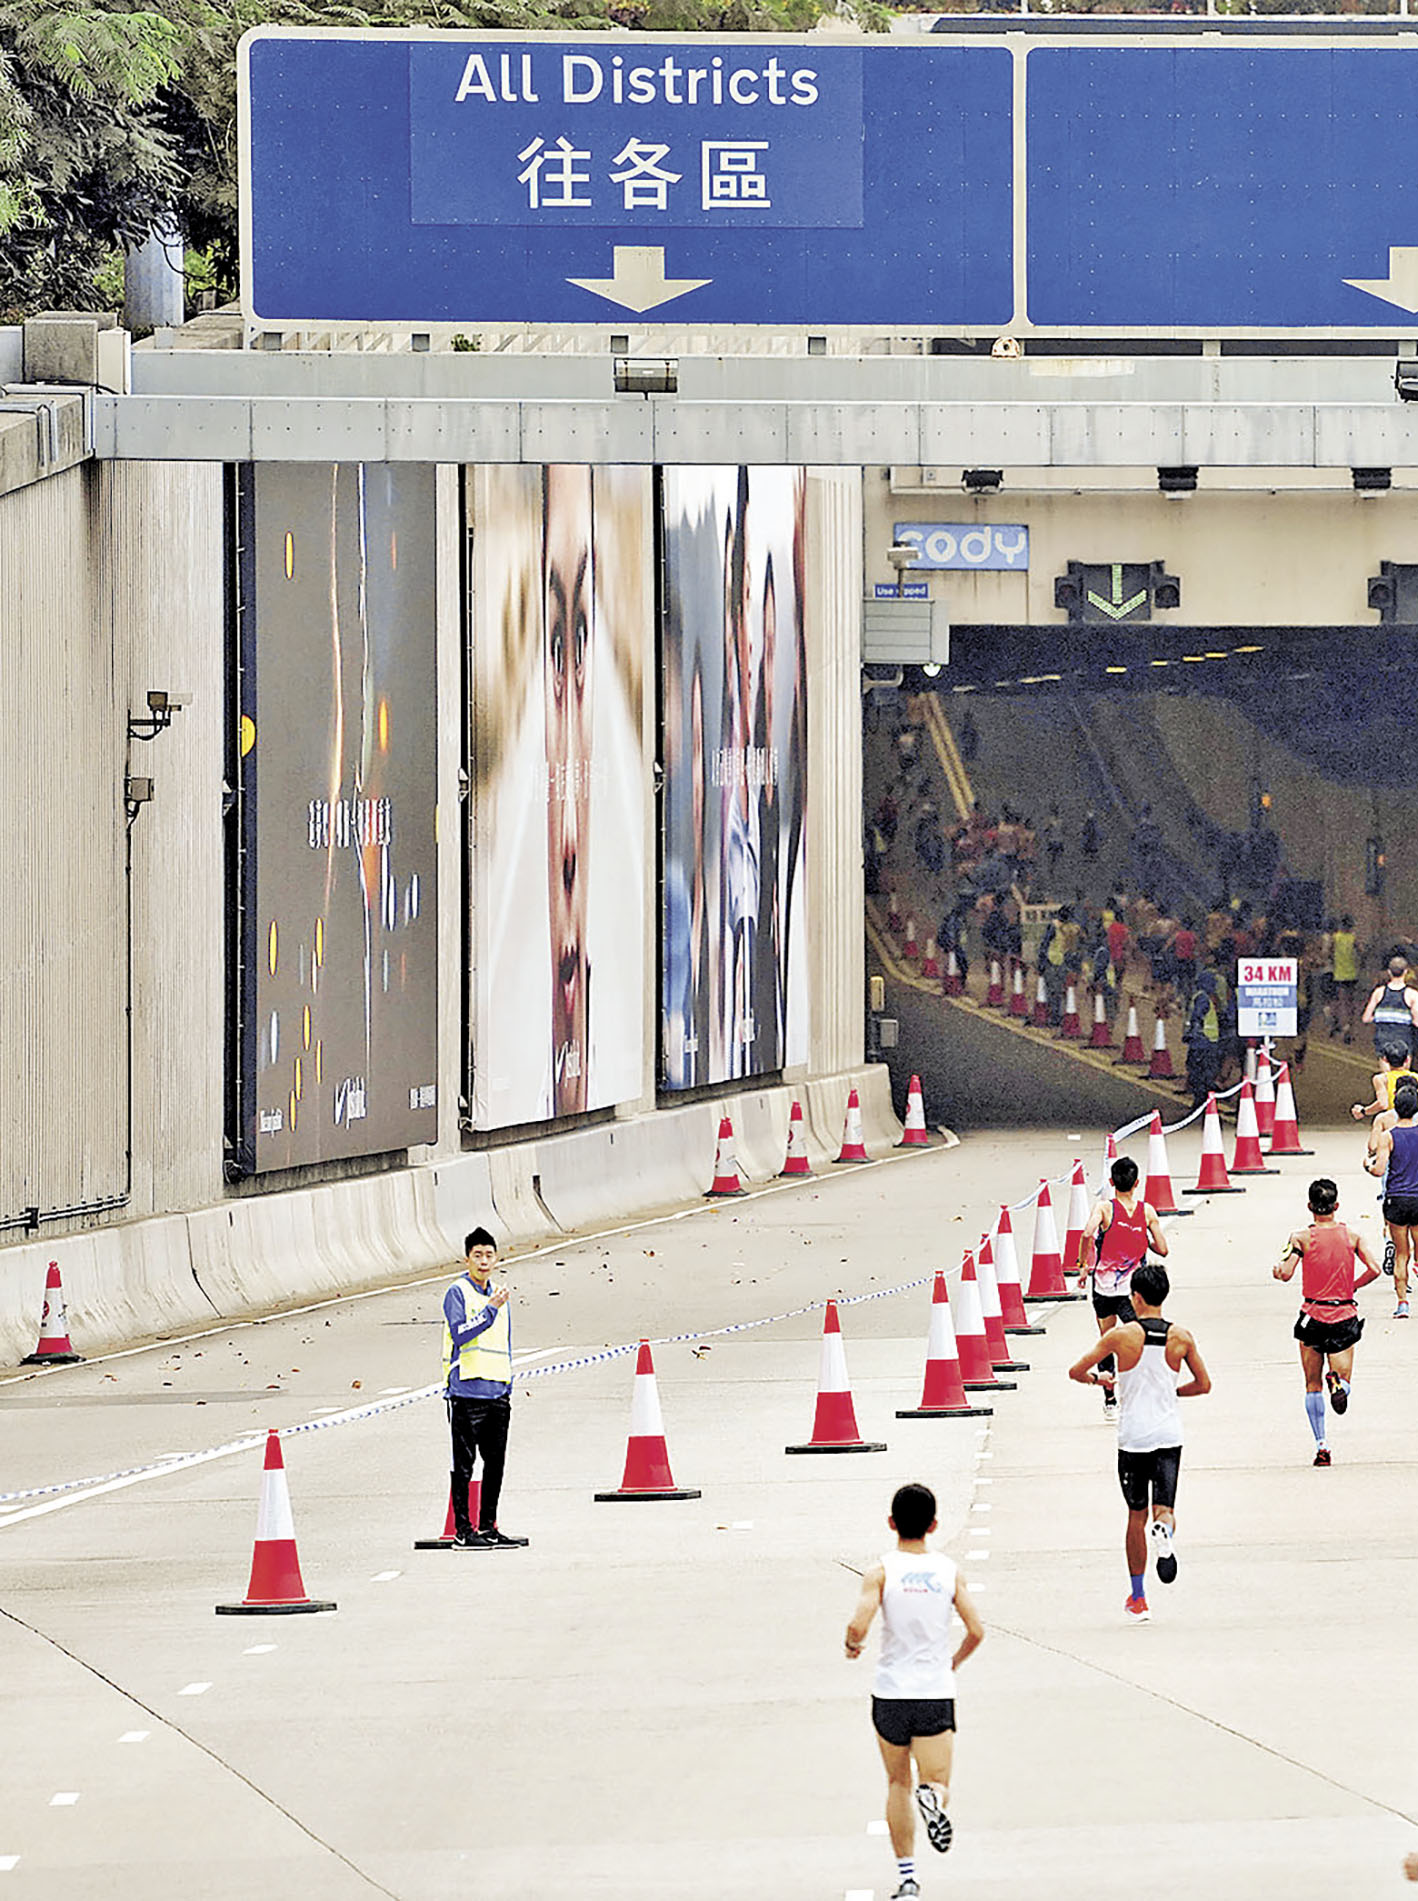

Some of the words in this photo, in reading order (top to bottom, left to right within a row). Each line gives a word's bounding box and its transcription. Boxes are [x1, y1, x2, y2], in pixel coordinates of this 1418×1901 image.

[455, 54, 538, 103] All
[562, 54, 819, 105] Districts
[517, 137, 771, 210] 往各區
[1244, 965, 1263, 982] 34
[1268, 965, 1292, 982] KM
